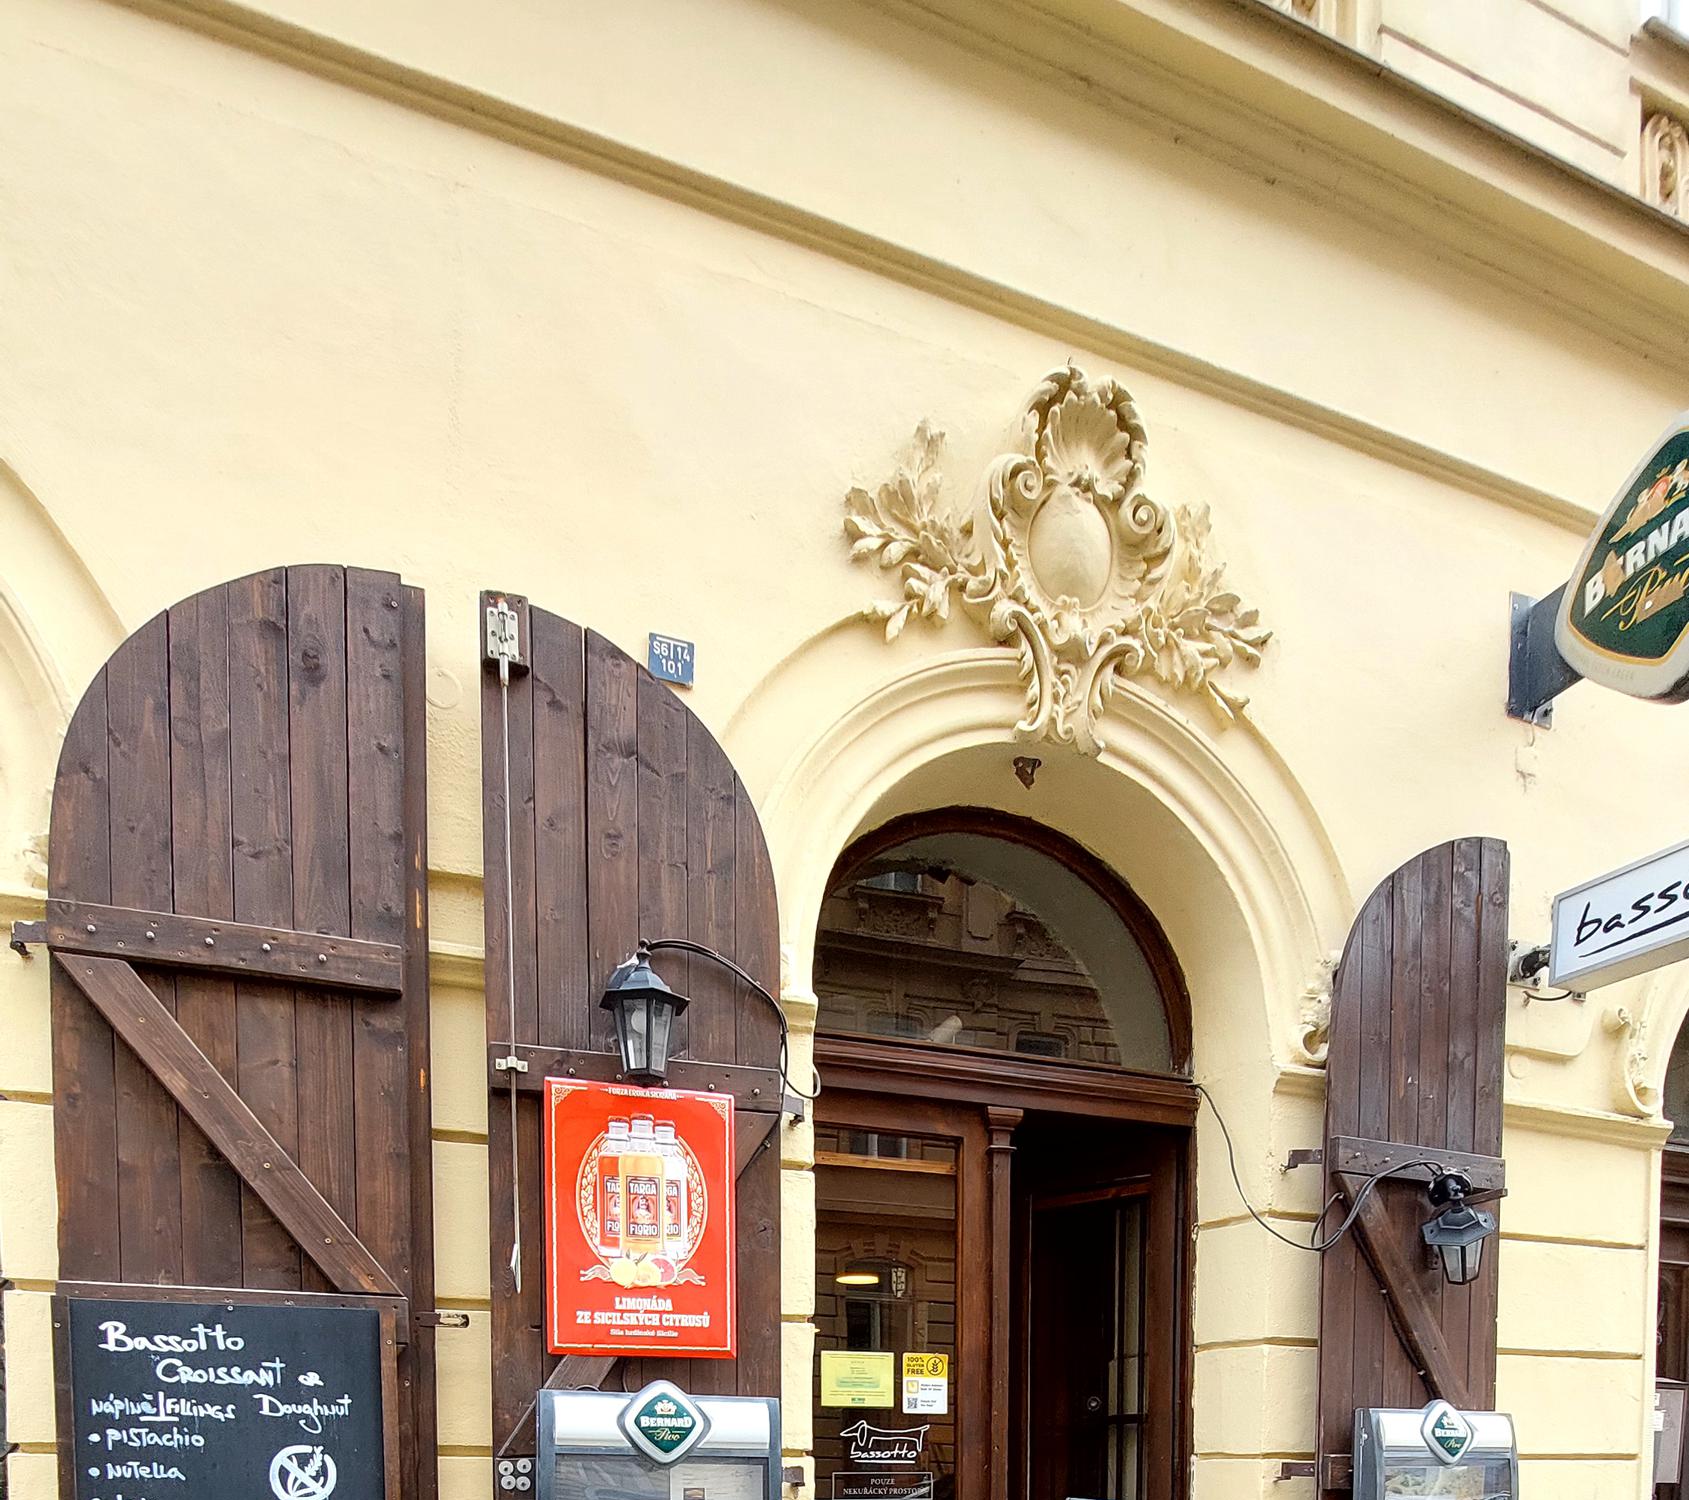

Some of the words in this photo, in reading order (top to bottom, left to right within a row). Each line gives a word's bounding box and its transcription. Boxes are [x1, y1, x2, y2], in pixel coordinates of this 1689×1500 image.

[1584, 508, 1689, 619] BRNA
[629, 1182, 657, 1195] TARGA
[630, 1224, 658, 1236] FLORIO
[615, 1295, 674, 1311] LIMONÁDA
[576, 1310, 592, 1324] ZE
[594, 1309, 660, 1326] SICILSKÝCH
[662, 1311, 710, 1328] CITRUSŮ
[640, 1412, 692, 1428] BERNARD
[850, 1441, 918, 1458] bassotto
[843, 1487, 888, 1496] NEKUŘÁCKÝ
